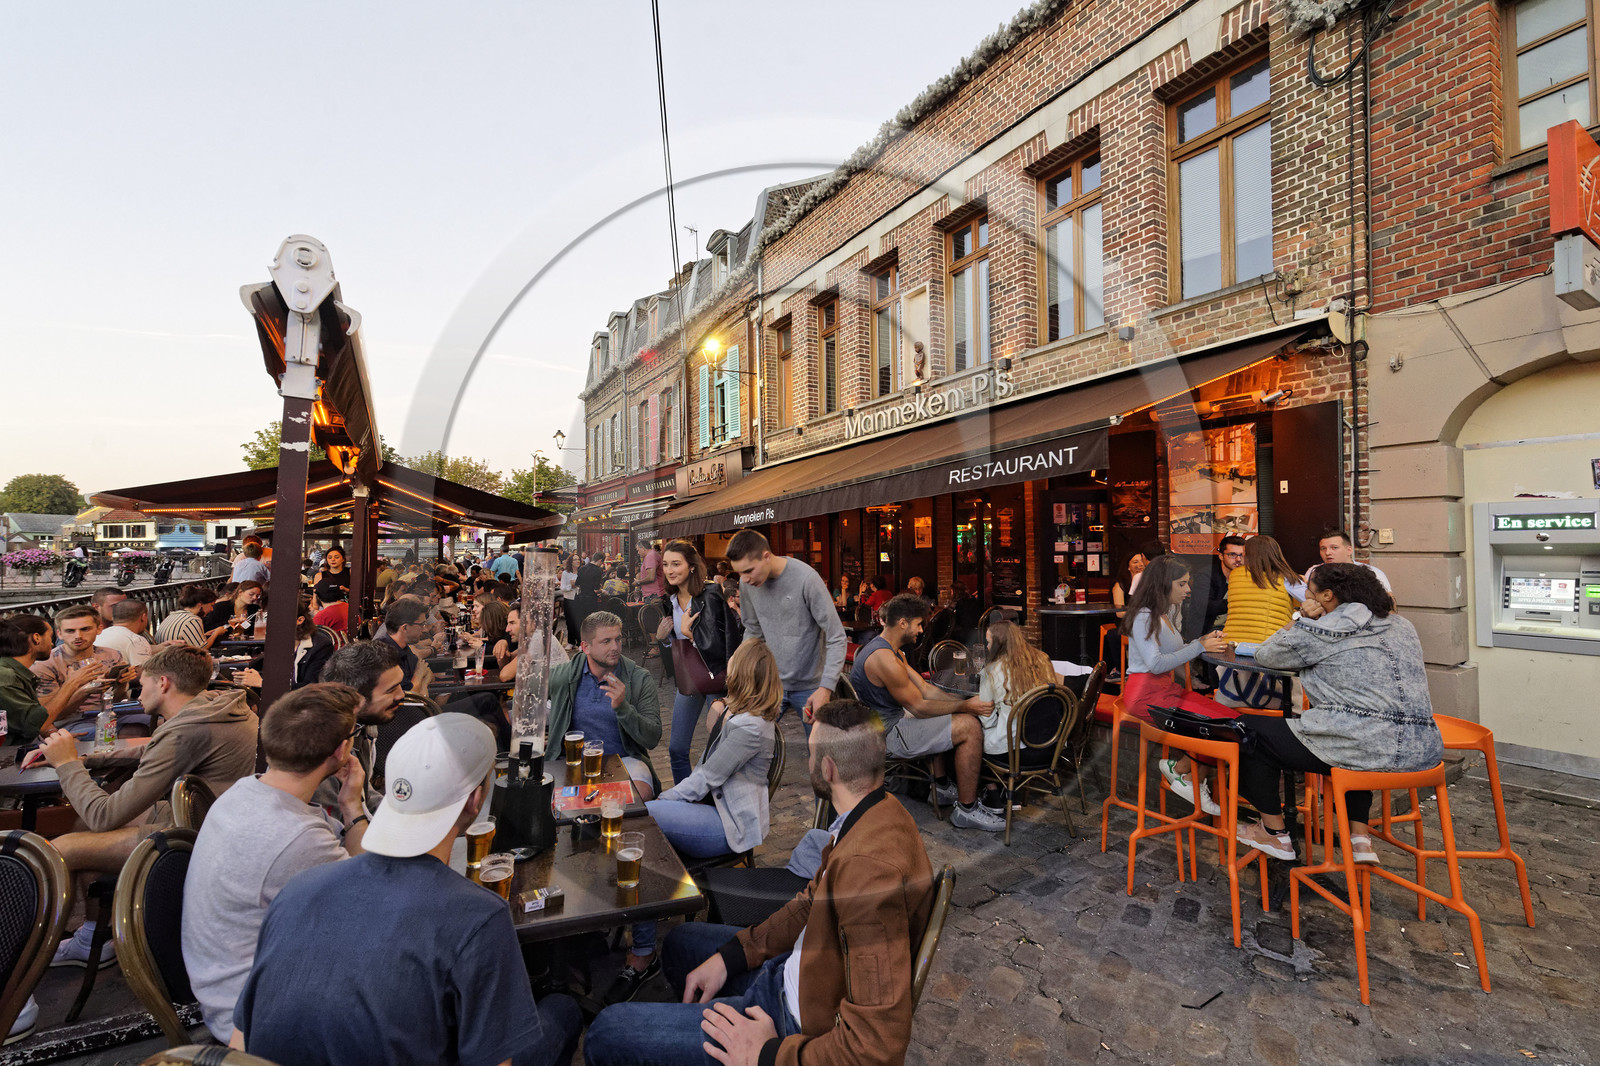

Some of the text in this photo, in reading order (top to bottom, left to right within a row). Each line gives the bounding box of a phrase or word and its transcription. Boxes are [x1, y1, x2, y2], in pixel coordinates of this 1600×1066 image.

[845, 369, 1010, 439] Manneken Pis
[948, 446, 1079, 485] RESTAURANT
[645, 478, 676, 493] RESTAURANT
[733, 507, 775, 526] Manneken Pis
[1497, 515, 1592, 529] En service
